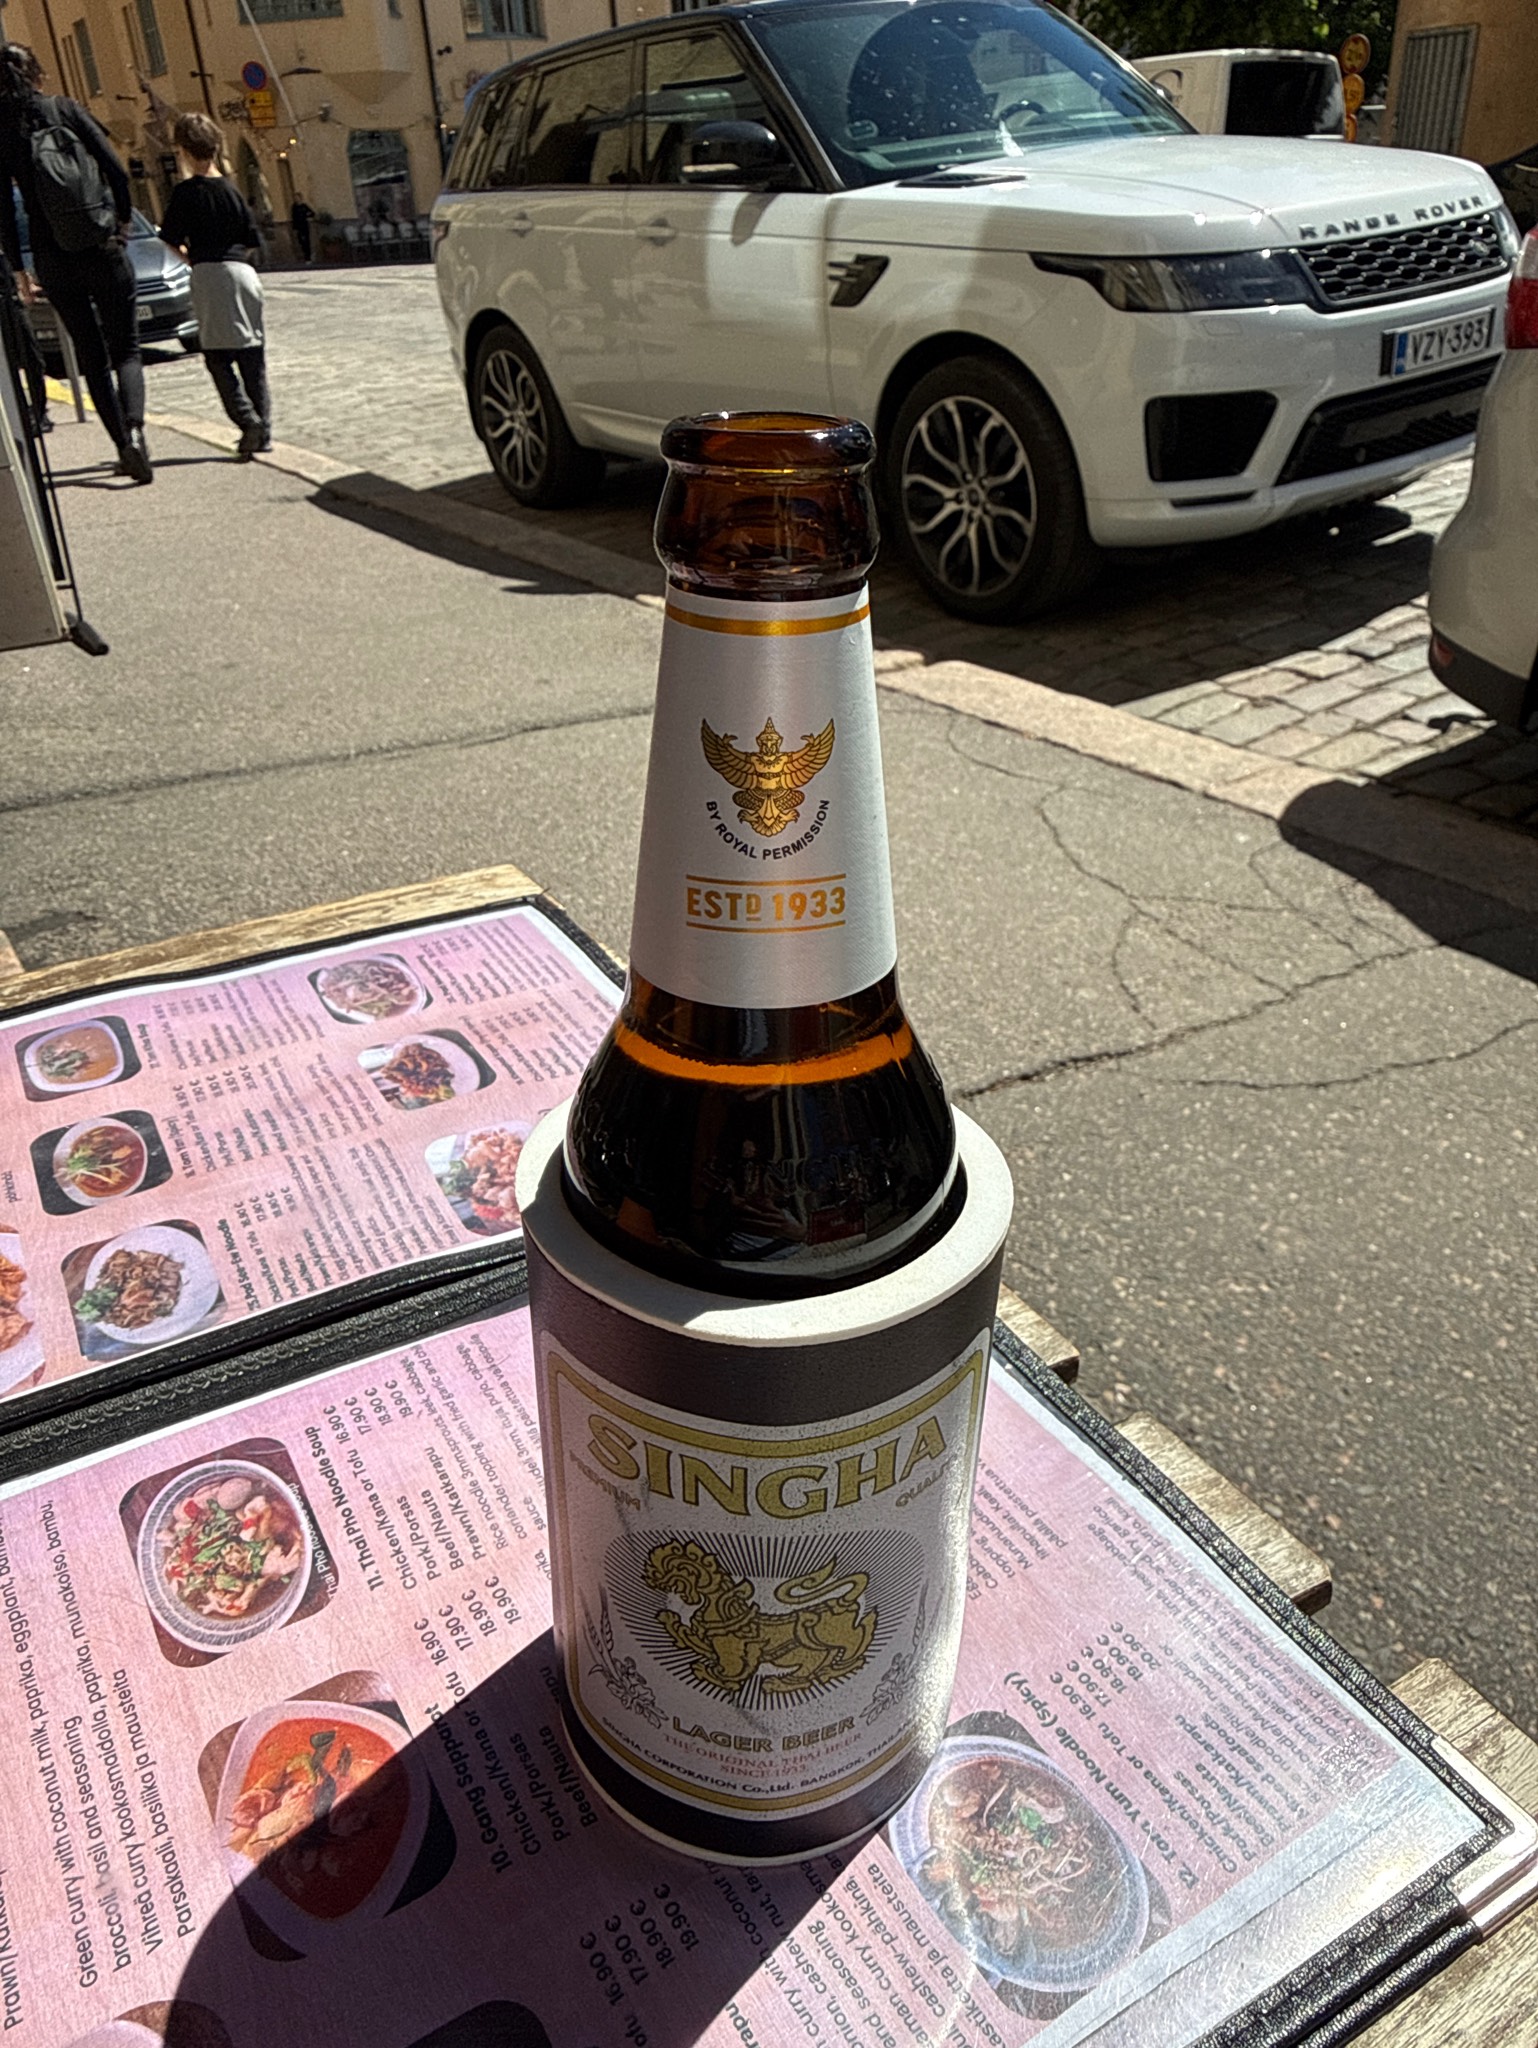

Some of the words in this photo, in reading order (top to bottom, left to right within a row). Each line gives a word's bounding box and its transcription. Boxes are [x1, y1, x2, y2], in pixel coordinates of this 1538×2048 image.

[1300, 214, 1399, 240] RANGE
[1414, 196, 1484, 221] ROVER
[1411, 317, 1486, 365] VZY-393
[706, 800, 722, 821] BY
[715, 823, 757, 859] ROYAL
[763, 800, 830, 860] PERMISSION
[687, 887, 761, 921] ESTD
[772, 886, 846, 921] 1933
[216, 1218, 236, 1251] Noodle
[246, 1230, 259, 1248] Tofu
[254, 1247, 264, 1255] or
[384, 1379, 398, 1390] €
[418, 1358, 437, 1375] and
[343, 1396, 358, 1407] €
[363, 1387, 378, 1397] €
[389, 1390, 414, 1418] 19.90
[430, 1375, 454, 1401] garlic
[499, 1380, 535, 1427] paistettua
[322, 1405, 337, 1415] €
[327, 1414, 351, 1444] 16.90
[349, 1406, 372, 1435] 17.90
[369, 1397, 393, 1426] 18.90
[442, 1400, 464, 1422] fried
[303, 1426, 327, 1458] Soup
[457, 1420, 476, 1442] with
[346, 1448, 367, 1478] Tofu
[470, 1441, 499, 1482] topping
[587, 1414, 947, 1520] SINGHA
[318, 1457, 348, 1508] Noodle
[360, 1478, 374, 1492] or
[468, 1479, 496, 1521] noodle
[984, 1468, 1037, 1518] paistettua
[340, 1507, 361, 1536] Pho
[423, 1446, 487, 1560] Prawn/Katkarapu
[492, 1483, 528, 1540] coriander
[522, 1496, 545, 1531] sauce
[39, 1499, 62, 1551] bambu,
[366, 1492, 418, 1590] Chicken/Kana
[395, 1495, 442, 1580] Pork/Porsas
[419, 1489, 465, 1570] Beef/Nauta
[488, 1522, 509, 1550] Rice
[312, 1550, 331, 1572] Pho
[348, 1534, 375, 1572] Thai
[974, 1535, 1016, 1579] topping
[52, 1549, 85, 1640] munakoiso,
[366, 1569, 384, 1591] 11.
[461, 1588, 477, 1602] €
[484, 1575, 500, 1588] €
[1, 1576, 32, 1654] eggplant,
[413, 1617, 430, 1631] €
[438, 1604, 454, 1617] €
[468, 1600, 497, 1637] 18.90
[491, 1587, 522, 1625] 19.90
[445, 1616, 474, 1651] 17.90
[1095, 1633, 1110, 1646] €
[1109, 1621, 1124, 1633] €
[420, 1630, 449, 1666] 16.90
[1065, 1659, 1080, 1673] €
[1079, 1645, 1095, 1659] €
[1108, 1646, 1144, 1681] 19.90
[1121, 1633, 1162, 1670] 20.90
[18, 1654, 48, 1721] paprika,
[75, 1639, 107, 1704] paprika,
[444, 1670, 471, 1709] Tofu
[1049, 1671, 1063, 1684] €
[1077, 1672, 1112, 1707] 17.90
[1091, 1658, 1127, 1694] 18.90
[112, 1668, 146, 1751] mausteita
[463, 1709, 481, 1727] or
[1002, 1671, 1059, 1728] (Spicy)
[1060, 1684, 1096, 1721] 16.90
[29, 1720, 53, 1762] milk,
[424, 1703, 474, 1788] Sapparot
[673, 1716, 773, 1752] LAGER
[782, 1716, 856, 1751] BEER
[697, 1748, 777, 1769] ORIGINAL
[826, 1732, 862, 1755] BEER
[1097, 1721, 1127, 1756] Tofu
[1201, 1712, 1264, 1773] seafoods
[62, 1715, 95, 1804] seasoning
[133, 1751, 157, 1772] ja
[602, 1717, 642, 1752] SINGHA
[645, 1750, 737, 1790] CORPORATION
[720, 1764, 772, 1779] SINCE
[1054, 1726, 1107, 1783] Noodle
[1126, 1754, 1144, 1769] or
[91, 1704, 136, 1842] kookosmaidolla,
[473, 1728, 542, 1855] Chicken/Kana
[508, 1732, 571, 1841] Pork/Porsas
[538, 1725, 598, 1827] Beef/Nauta
[1174, 1714, 1291, 1832] Prawn/Katkarapu
[39, 1762, 67, 1833] coconut
[139, 1770, 169, 1839] basilika
[464, 1785, 500, 1845] Gang
[1104, 1781, 1141, 1823] Yum
[1172, 1770, 1257, 1861] Pork/Porsas
[79, 1804, 103, 1840] and
[1142, 1769, 1237, 1873] Chicken/Kana
[52, 1833, 75, 1874] with
[490, 1843, 513, 1874] 10.
[1139, 1820, 1177, 1864] Tom
[125, 1841, 149, 1889] curry
[63, 1874, 87, 1925] curry
[155, 1836, 196, 1937] Parsakaali,
[653, 1882, 671, 1900] €
[866, 1863, 930, 1948] mausteita
[133, 1889, 163, 1955] Vihreä
[604, 1914, 622, 1933] €
[629, 1898, 647, 1916] €
[663, 1900, 699, 1951] 19.90
[713, 1876, 763, 1946] coconut
[758, 1892, 785, 1928] nut,
[73, 1925, 98, 1988] Green
[579, 1931, 597, 1950] €
[614, 1933, 649, 1986] 17.90
[639, 1917, 675, 1969] 18.90
[843, 1875, 946, 2018] cashew-pähkinä,
[926, 1947, 948, 1966] ja
[589, 1951, 625, 2006] 16.90
[757, 1946, 788, 1987] with
[779, 1929, 827, 1995] cashew
[807, 1919, 871, 2010] seasoning
[854, 1944, 892, 1991] curry
[783, 1987, 820, 2037] curry
[862, 2011, 896, 2048] and
